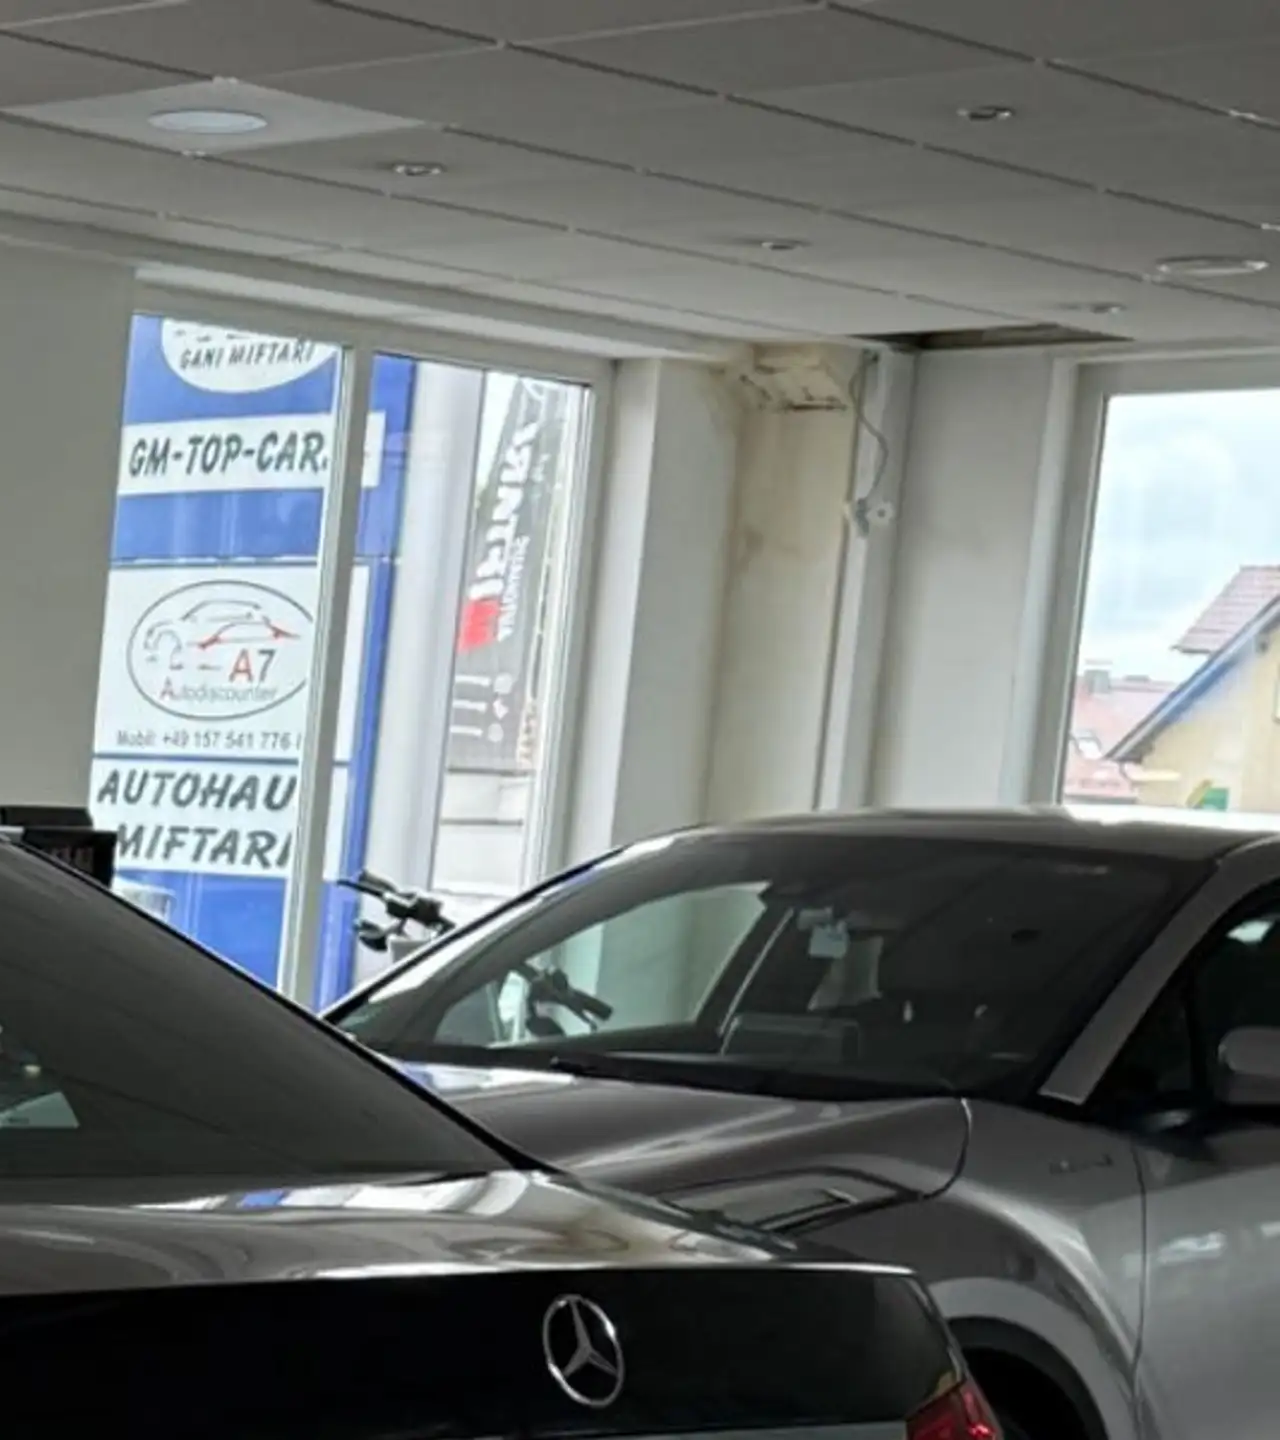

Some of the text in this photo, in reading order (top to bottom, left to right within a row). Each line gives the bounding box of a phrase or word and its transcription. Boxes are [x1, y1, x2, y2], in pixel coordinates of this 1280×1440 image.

[180, 346, 225, 370] GANI
[128, 430, 328, 478] GM-TOP-CAR
[228, 648, 277, 683] A7
[116, 824, 293, 869] MIFTARI
